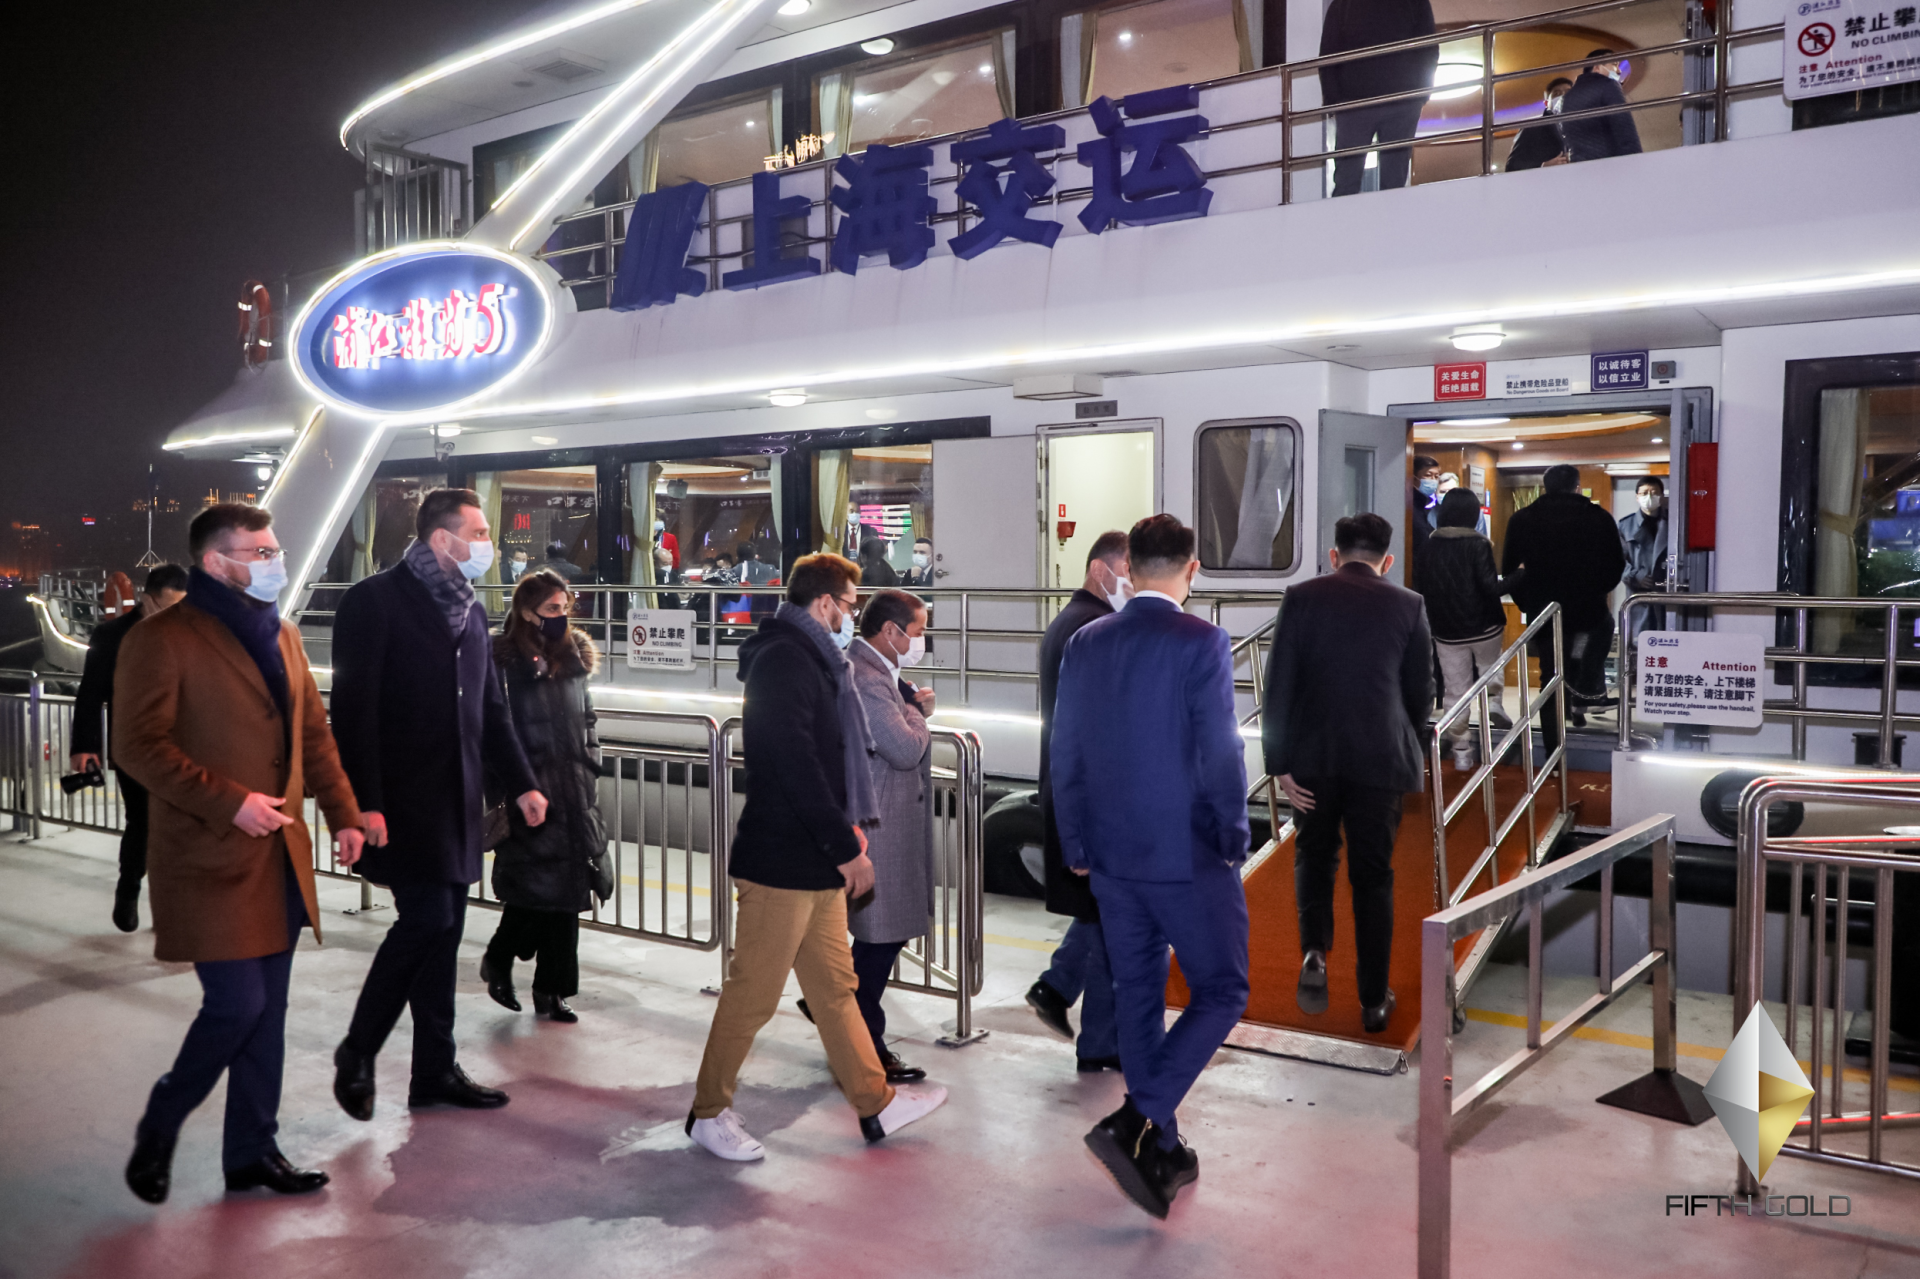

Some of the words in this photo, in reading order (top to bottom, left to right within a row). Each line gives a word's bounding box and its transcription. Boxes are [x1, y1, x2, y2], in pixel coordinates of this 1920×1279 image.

[1844, 7, 1920, 37] 禁止攀
[1851, 39, 1869, 49] NO
[1871, 29, 1920, 45] CLIMBIN
[1799, 63, 1818, 74] 注意
[1825, 54, 1882, 69] Attention
[722, 84, 1214, 291] 上海交运
[1598, 358, 1642, 371] 以诚待客
[1441, 369, 1480, 381] 关爱生命
[1598, 371, 1641, 384] 以信立业
[1441, 382, 1480, 393] 拒绝超载
[1506, 377, 1569, 389] 禁止携带危险品登船
[649, 627, 685, 640] 禁止攀爬
[1645, 656, 1668, 668] 注意
[1702, 661, 1757, 672] Attention
[1655, 701, 1668, 709] your
